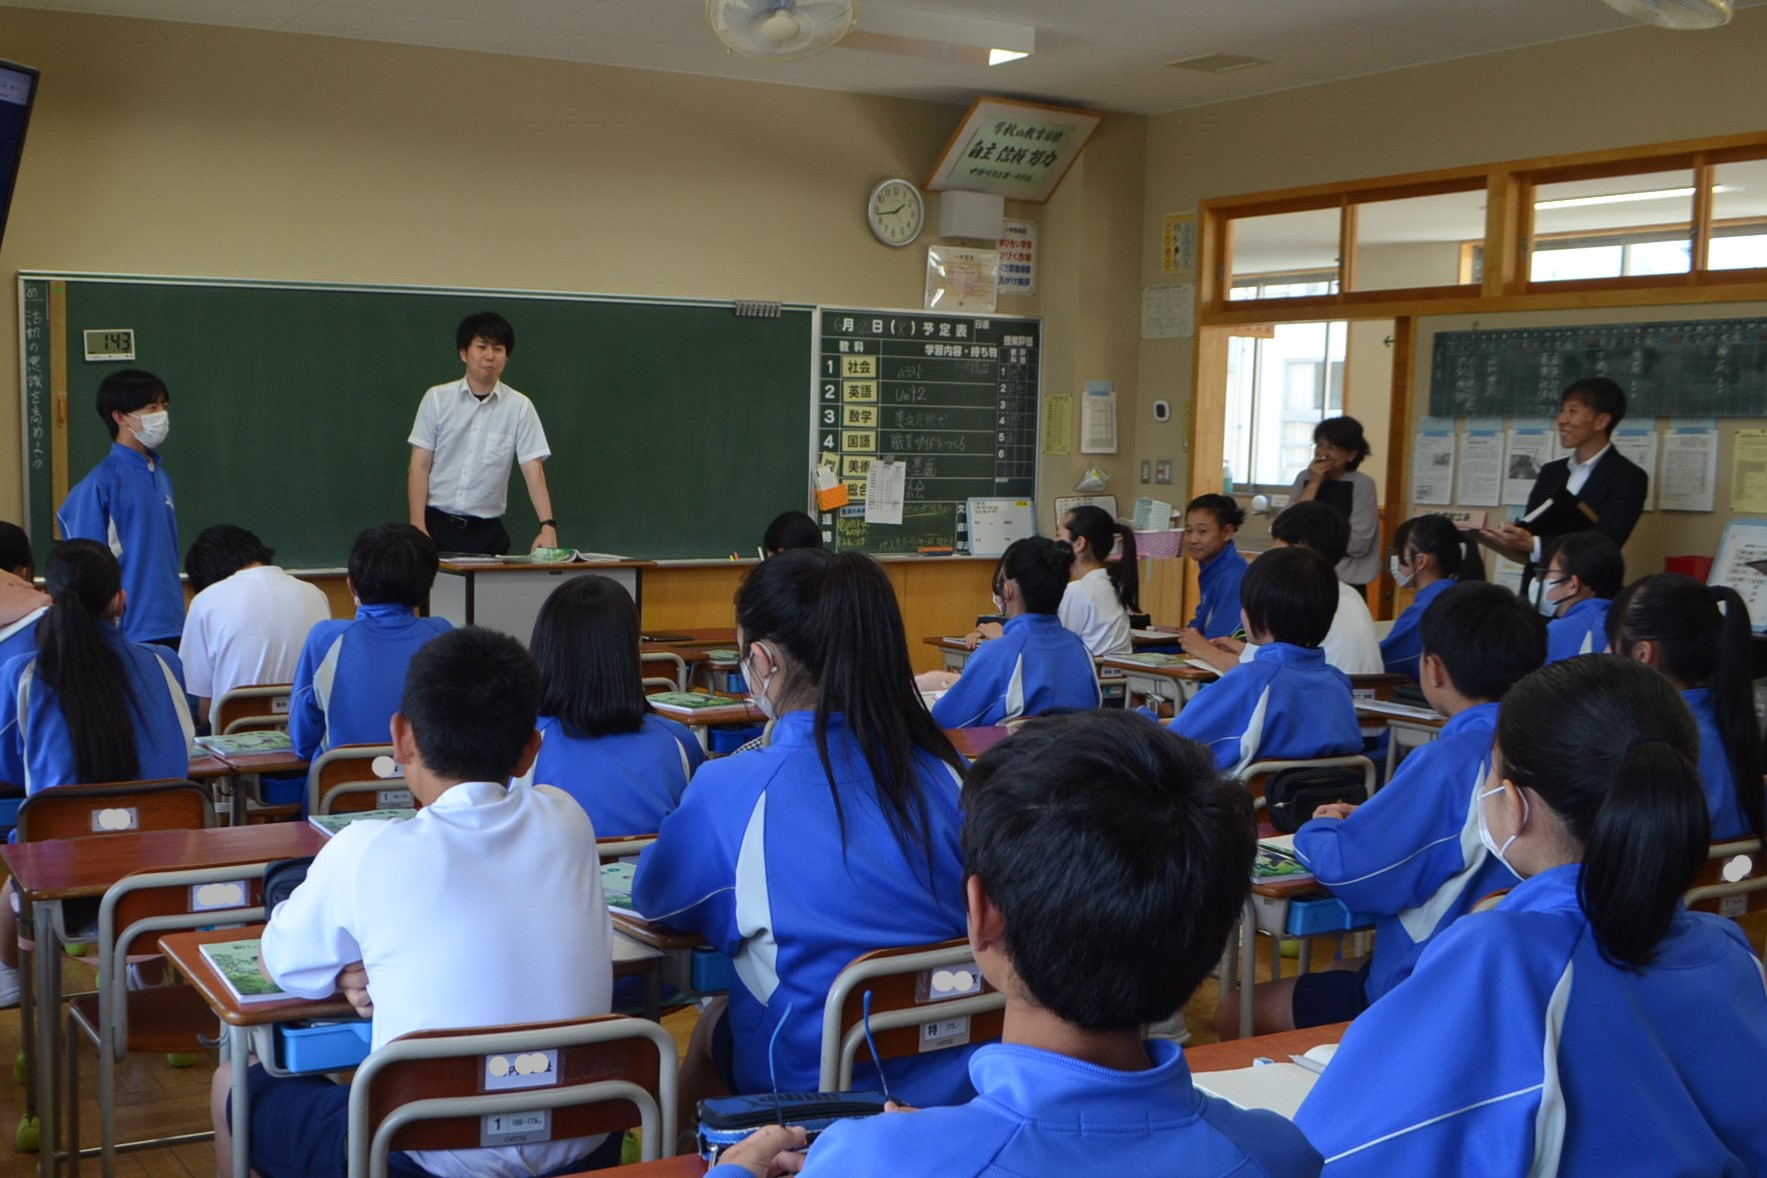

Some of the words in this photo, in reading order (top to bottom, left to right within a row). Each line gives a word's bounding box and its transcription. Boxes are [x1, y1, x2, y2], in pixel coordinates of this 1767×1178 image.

[827, 359, 833, 374] 1
[848, 360, 871, 374] 社会
[824, 384, 835, 399] 2
[848, 384, 872, 398] 英語
[824, 409, 835, 424] 3
[848, 409, 872, 424] 数学
[823, 434, 834, 448] 4
[847, 434, 871, 448] 国語
[494, 1117, 501, 1131] 1
